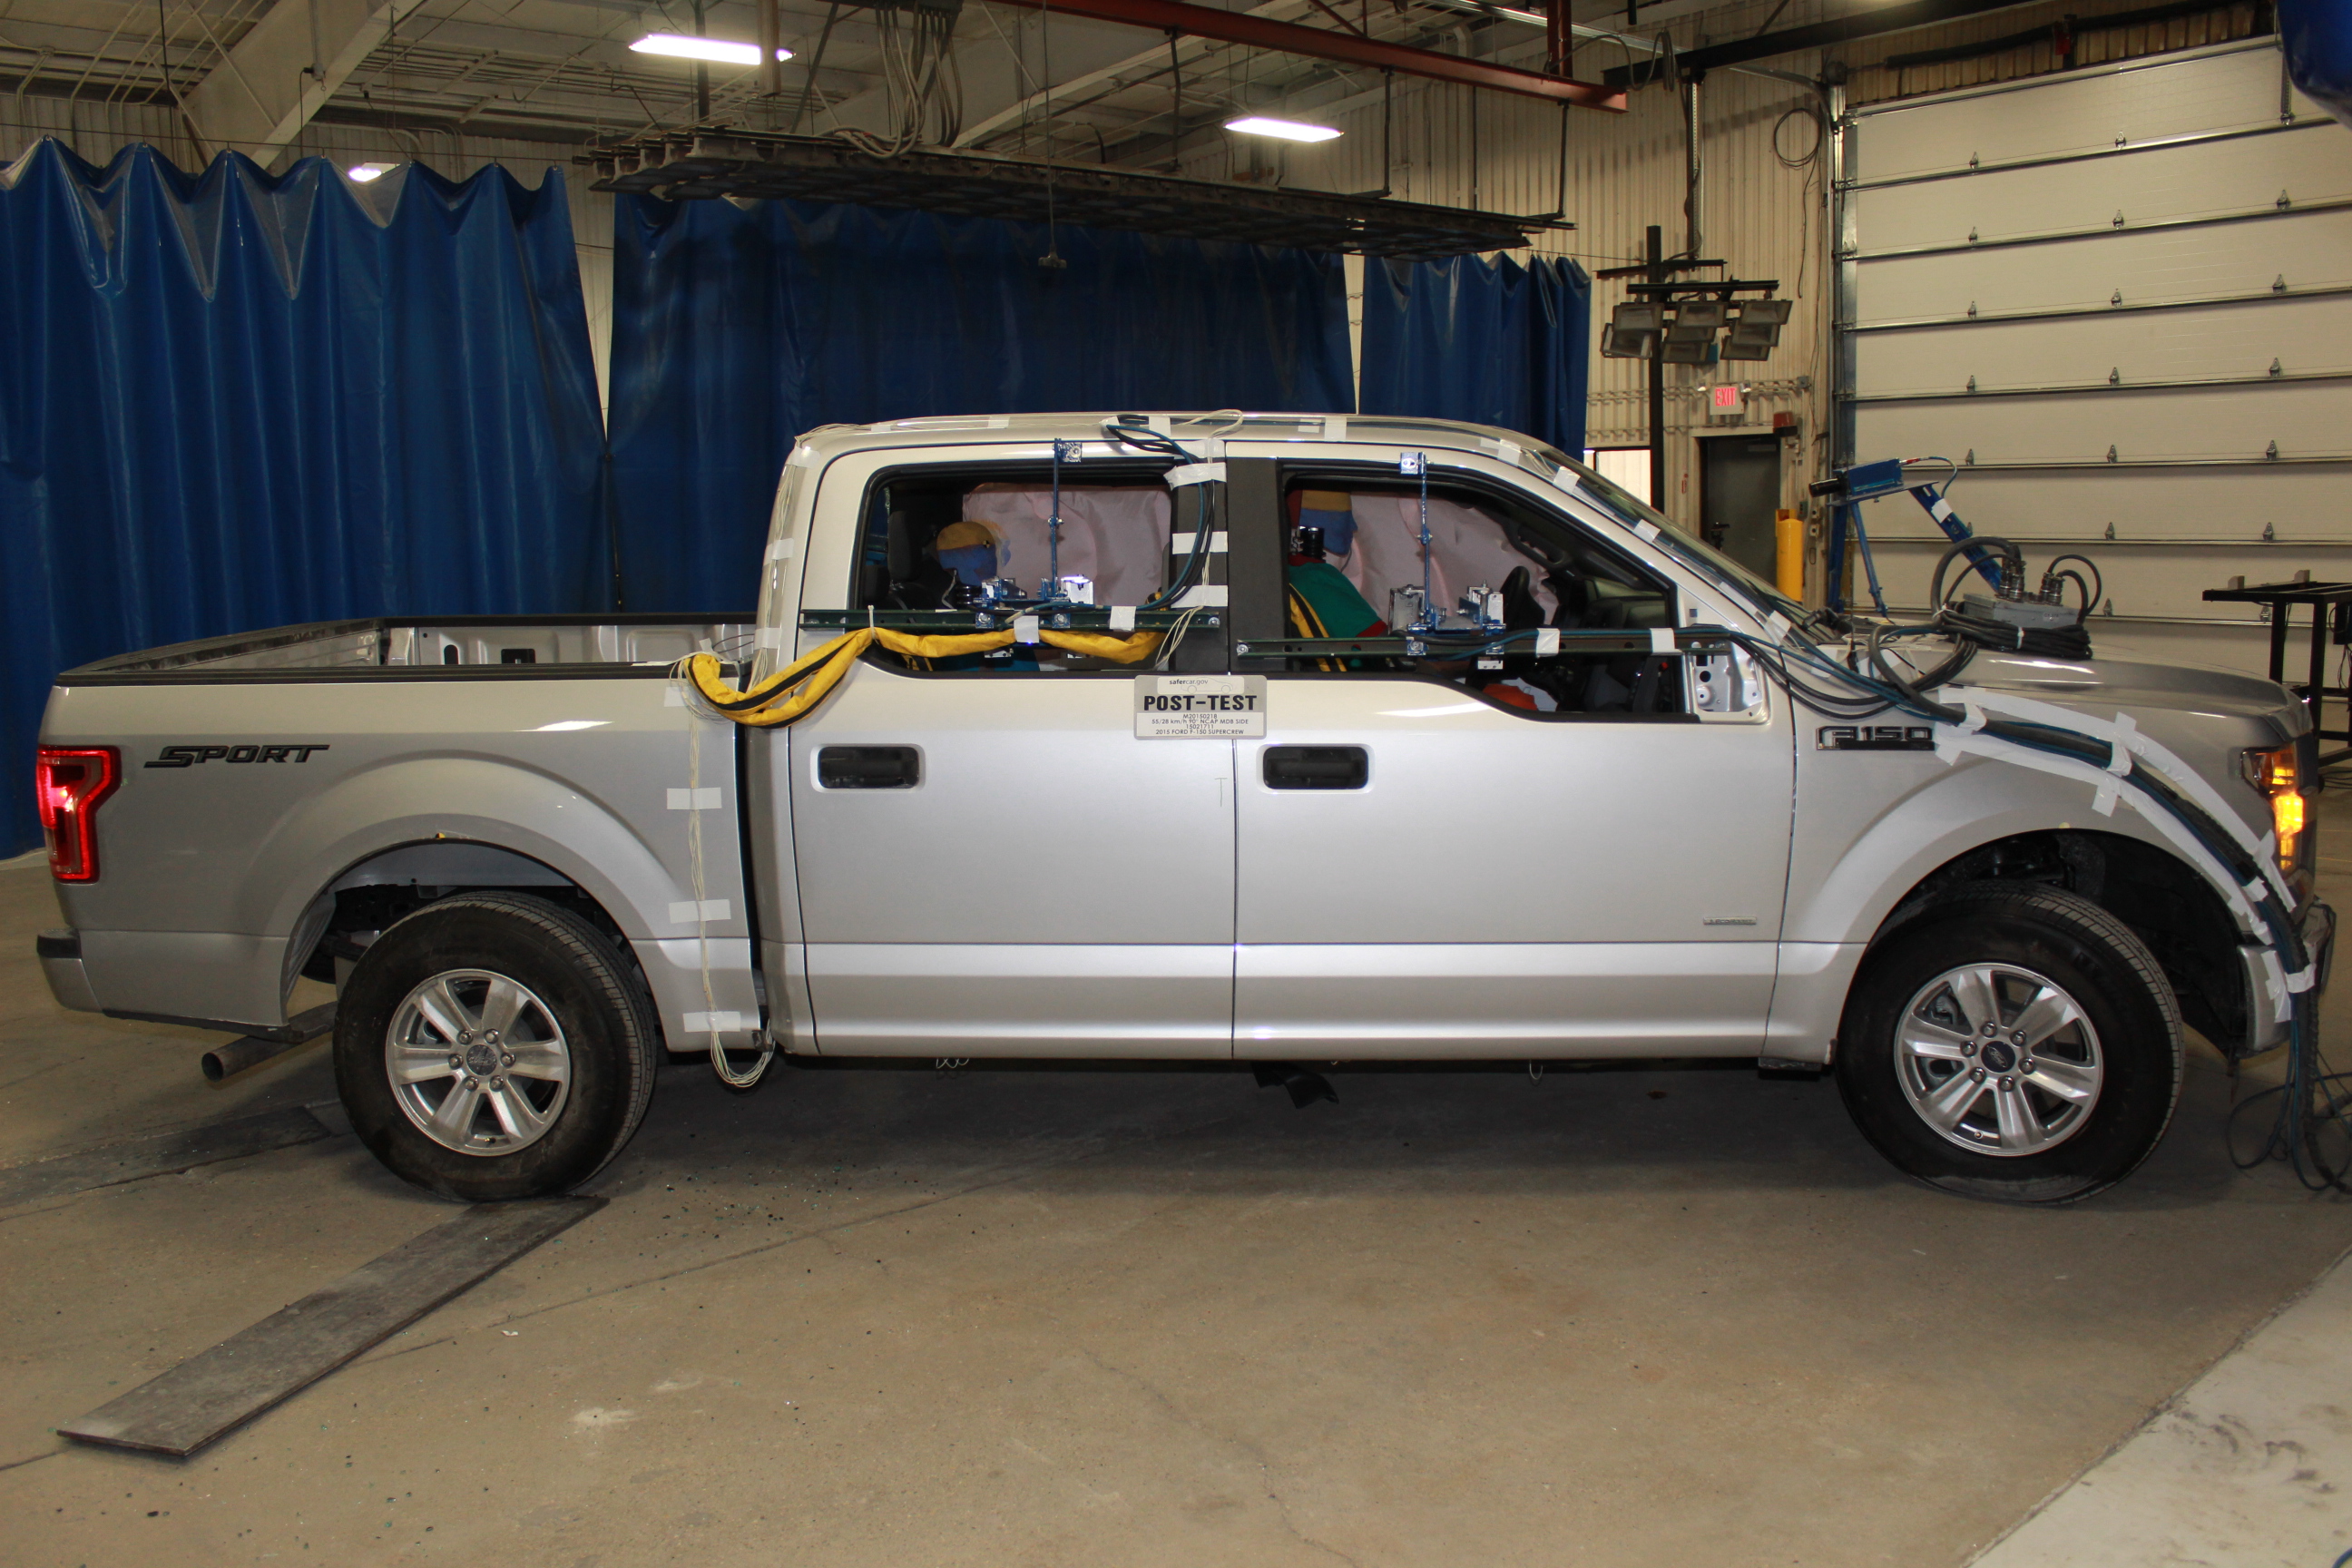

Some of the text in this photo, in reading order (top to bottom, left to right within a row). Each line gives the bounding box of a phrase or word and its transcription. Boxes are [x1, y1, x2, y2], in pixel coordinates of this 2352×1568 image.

[1714, 387, 1737, 407] EXIT
[1169, 678, 1209, 686] safercar.gov
[1143, 694, 1258, 711] POST-TEST
[143, 744, 330, 768] SPORT
